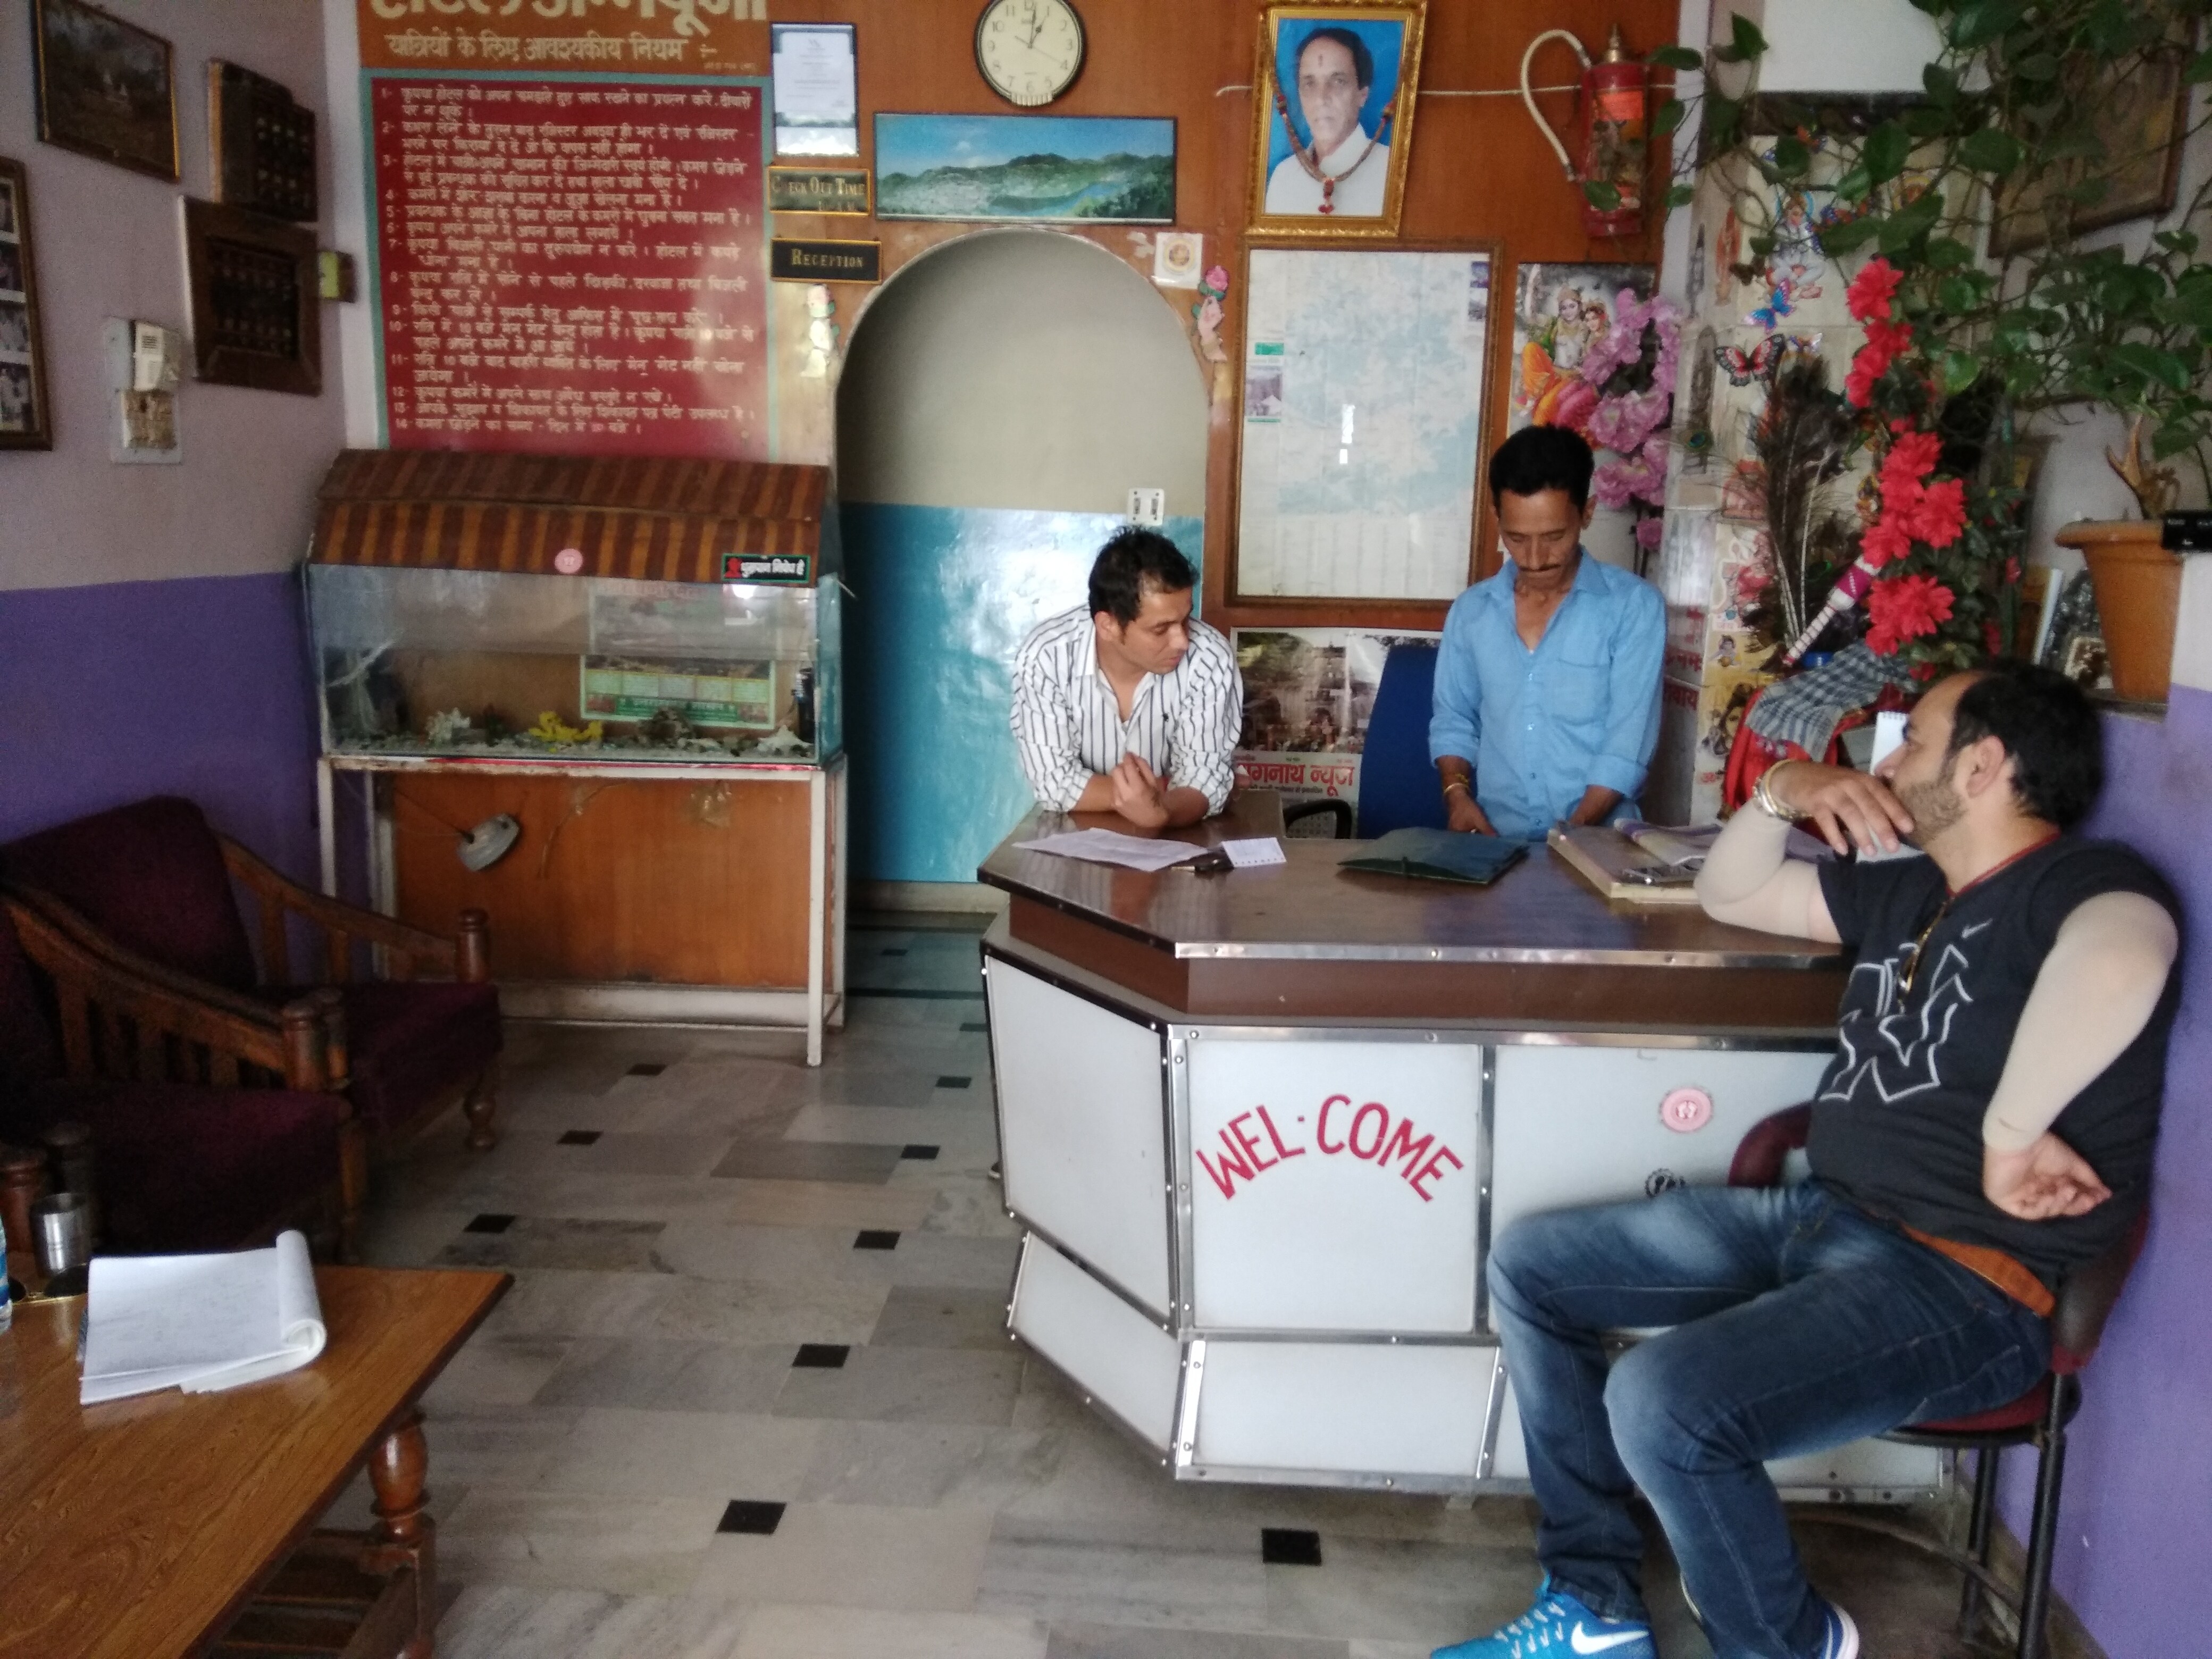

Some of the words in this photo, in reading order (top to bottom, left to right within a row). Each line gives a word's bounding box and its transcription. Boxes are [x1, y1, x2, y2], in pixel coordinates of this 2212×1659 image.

[384, 27, 453, 57] यात्रियों
[456, 27, 476, 57] के
[629, 31, 689, 61] नियम
[773, 175, 807, 192] CECK
[791, 248, 863, 267] RECEPTION
[1310, 765, 1355, 797] न्यूज
